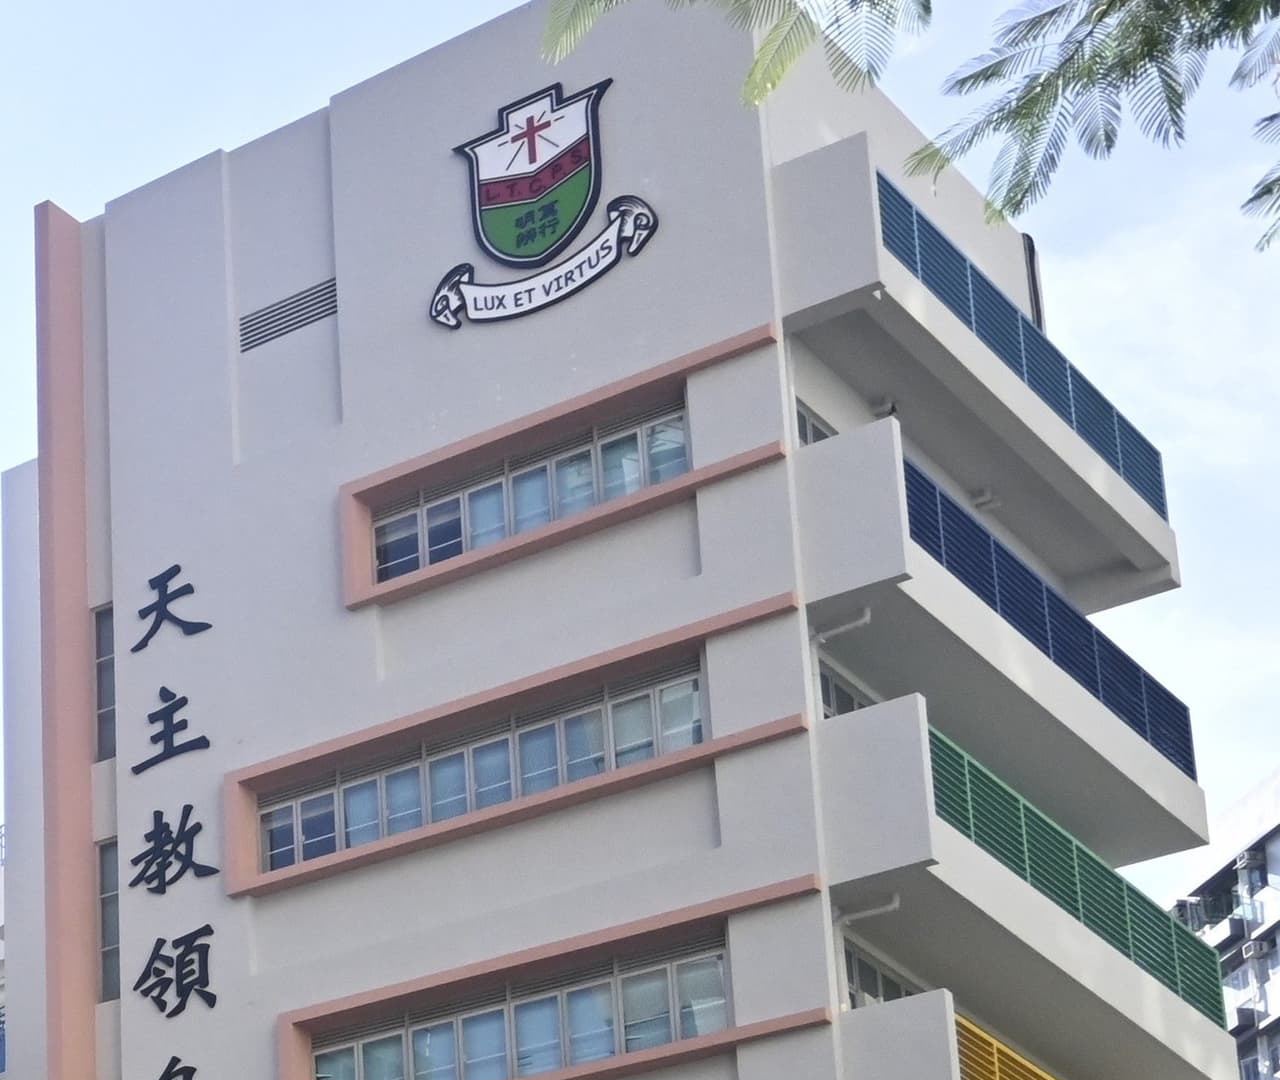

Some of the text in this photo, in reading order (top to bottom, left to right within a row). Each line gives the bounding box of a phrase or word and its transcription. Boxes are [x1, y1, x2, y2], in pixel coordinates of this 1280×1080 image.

[472, 238, 614, 312] LUX ET VIRTUS
